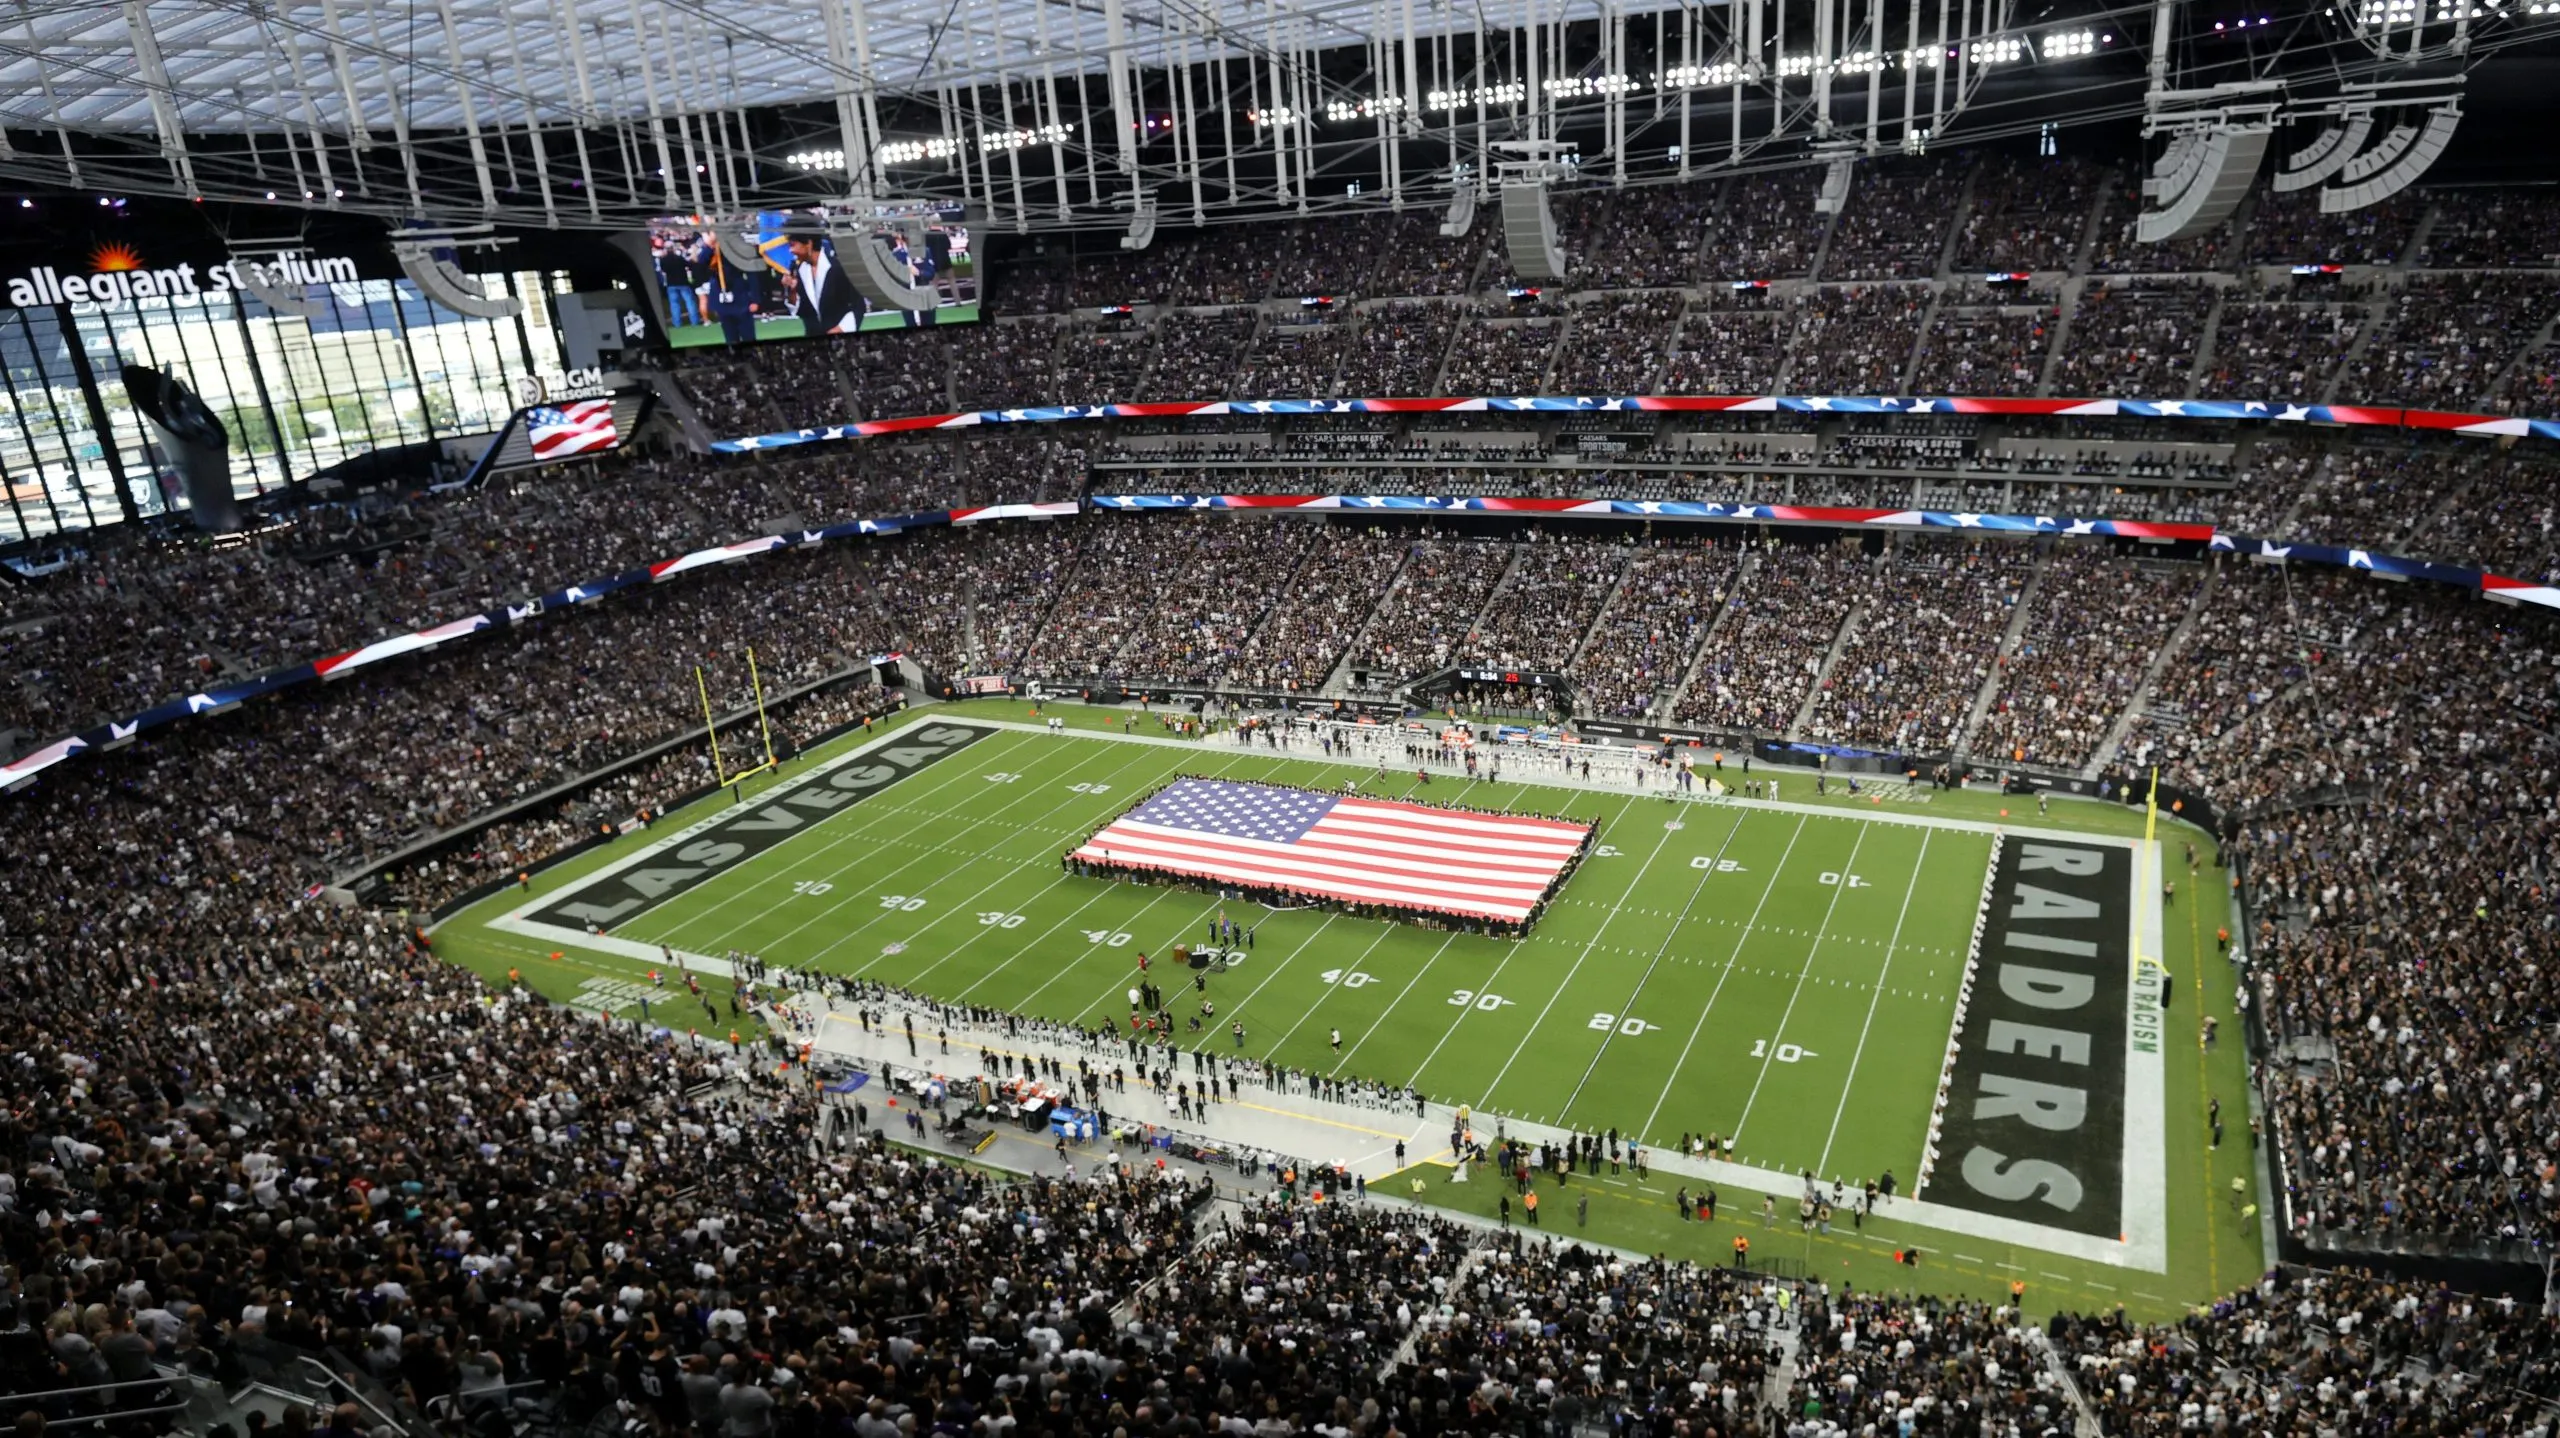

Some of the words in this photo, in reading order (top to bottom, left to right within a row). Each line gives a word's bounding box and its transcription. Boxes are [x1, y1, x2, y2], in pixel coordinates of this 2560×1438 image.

[8, 262, 201, 311] allegiant
[1460, 670, 1472, 679] 1st
[1505, 673, 1518, 683] 25
[555, 839, 745, 924] LAS
[726, 727, 975, 832] VEGAS
[980, 911, 1027, 929] 30
[1086, 929, 1133, 948] 40
[1320, 968, 1371, 989] 40
[1447, 989, 1504, 1012] 30
[1588, 1012, 1647, 1037] 20
[1961, 842, 2104, 1213] RAIDERS
[2132, 993, 2159, 1054] RACISM
[1750, 1039, 1803, 1063] 10
